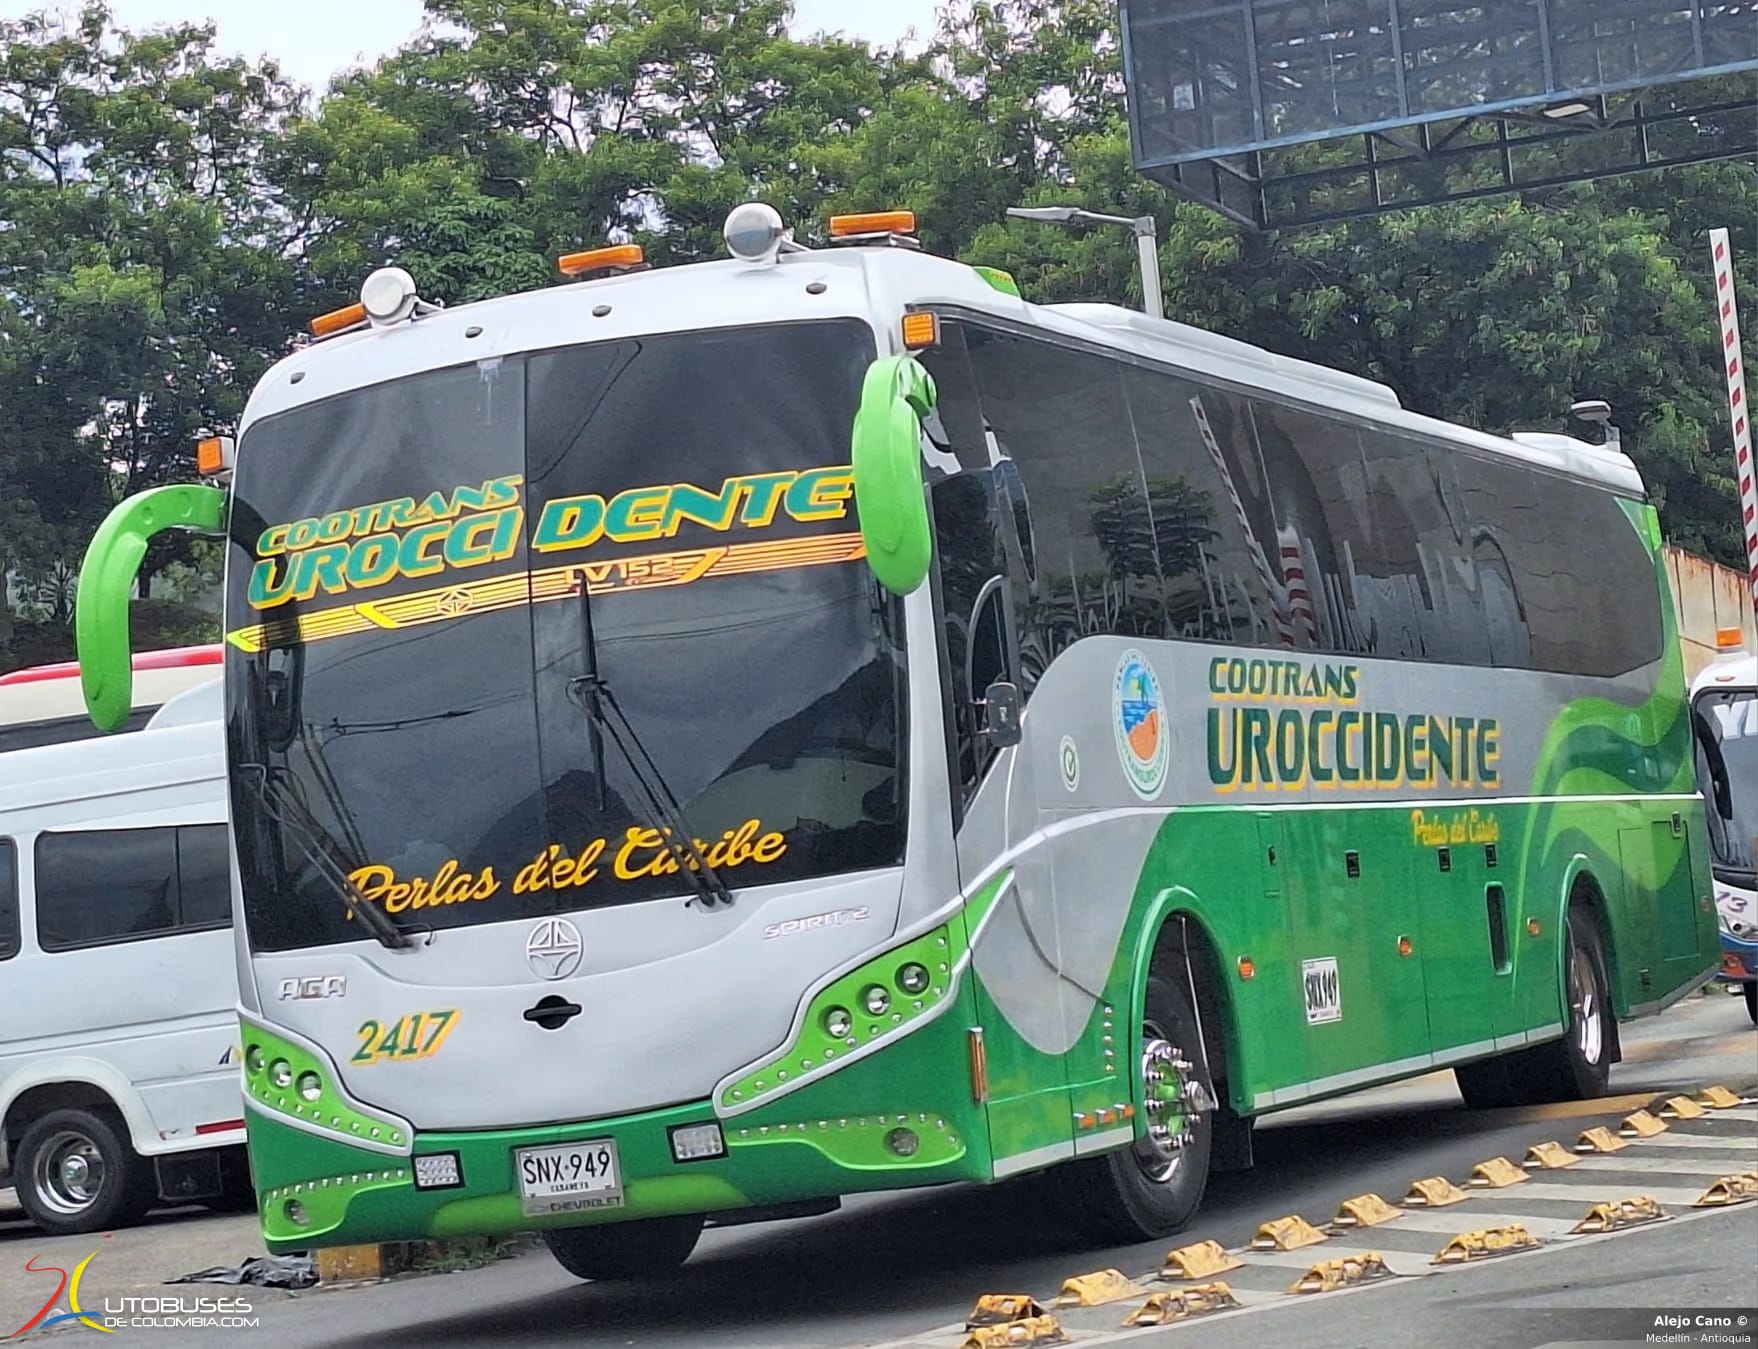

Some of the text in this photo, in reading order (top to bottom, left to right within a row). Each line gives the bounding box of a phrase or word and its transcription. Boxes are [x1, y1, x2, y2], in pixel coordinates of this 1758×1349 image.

[247, 465, 854, 610] UROCCI DENTE
[257, 474, 524, 557] COOTRANS
[1209, 657, 1360, 705] COOTRANS
[1207, 707, 1501, 793] UROCCIDENTE
[346, 860, 502, 920] Perlas
[614, 818, 787, 881] Caribe
[763, 910, 848, 940] SPIRIT
[279, 975, 348, 1002] AGA
[350, 1008, 463, 1066] 2417
[550, 1196, 621, 1212] CHEVROLET
